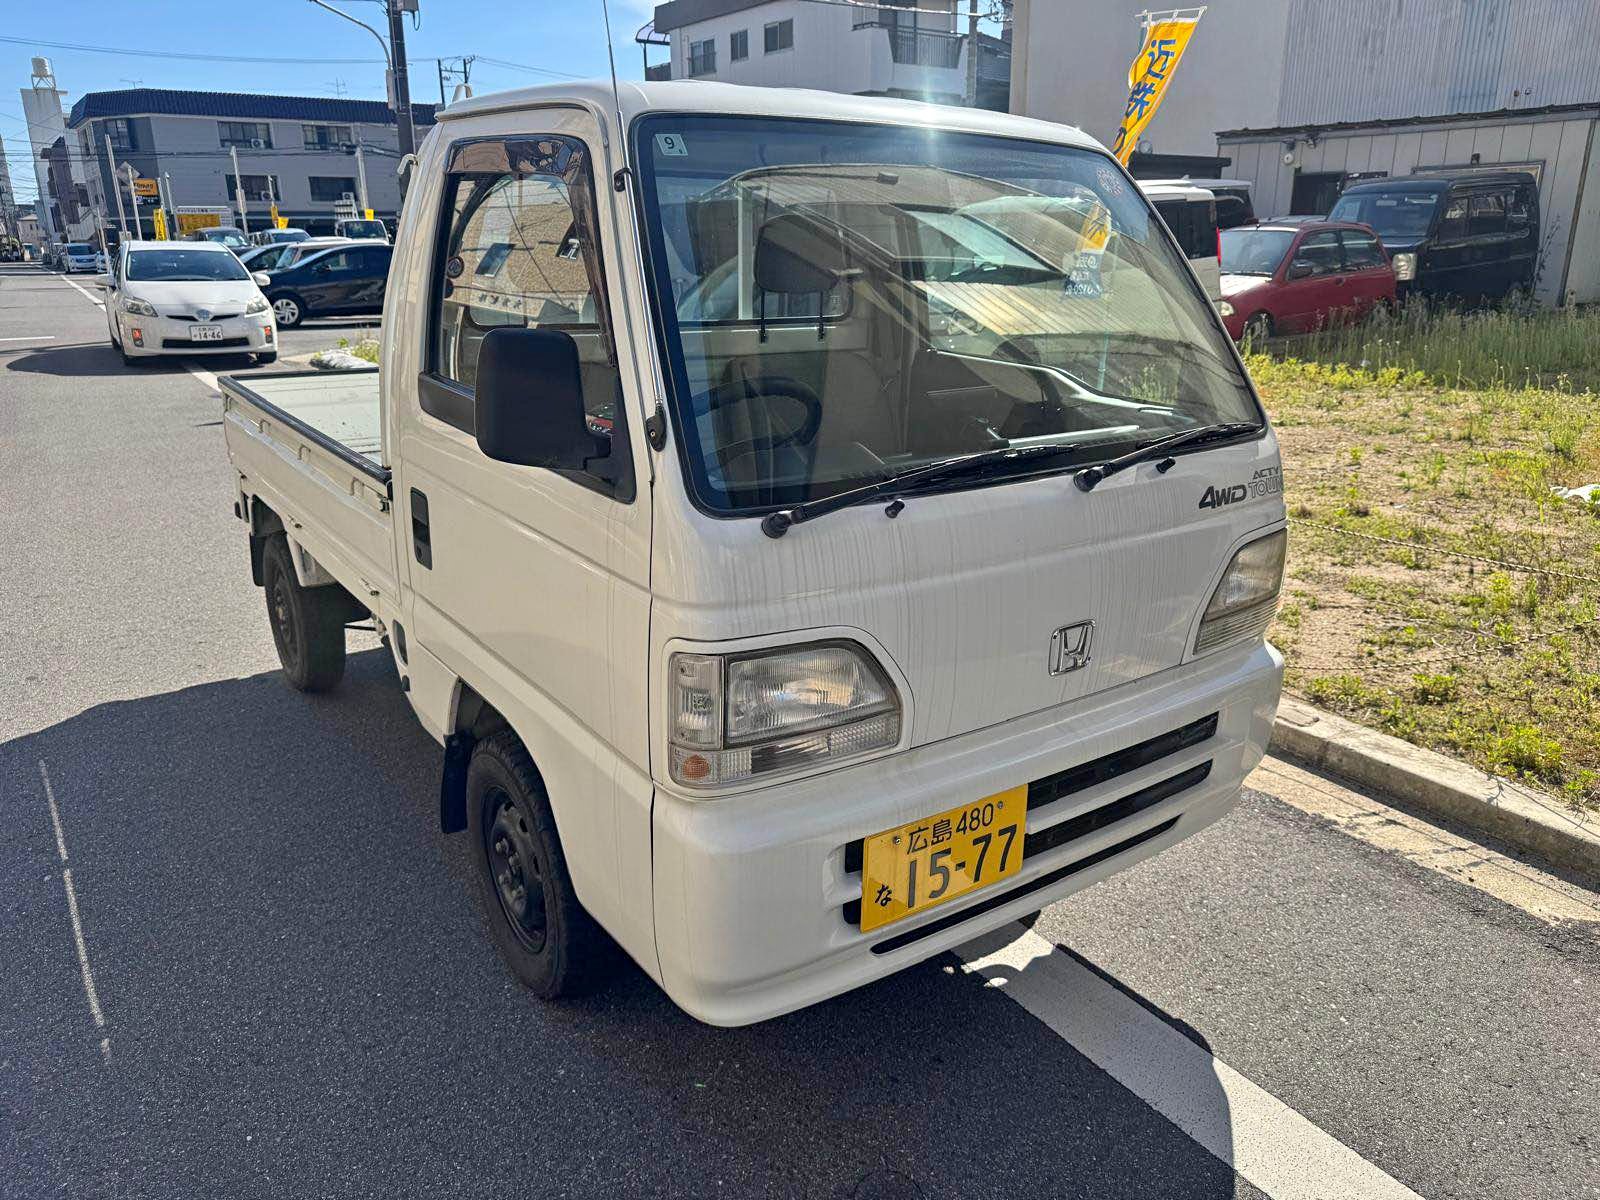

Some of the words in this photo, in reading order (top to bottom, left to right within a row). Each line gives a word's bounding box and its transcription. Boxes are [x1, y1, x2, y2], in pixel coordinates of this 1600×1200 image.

[664, 136, 675, 149] 9
[1252, 466, 1280, 480] ACTY
[1198, 484, 1247, 509] 4WD
[906, 819, 953, 855] 広島
[956, 802, 995, 835] 480
[875, 884, 894, 907] な
[907, 824, 1018, 908] 15-77
